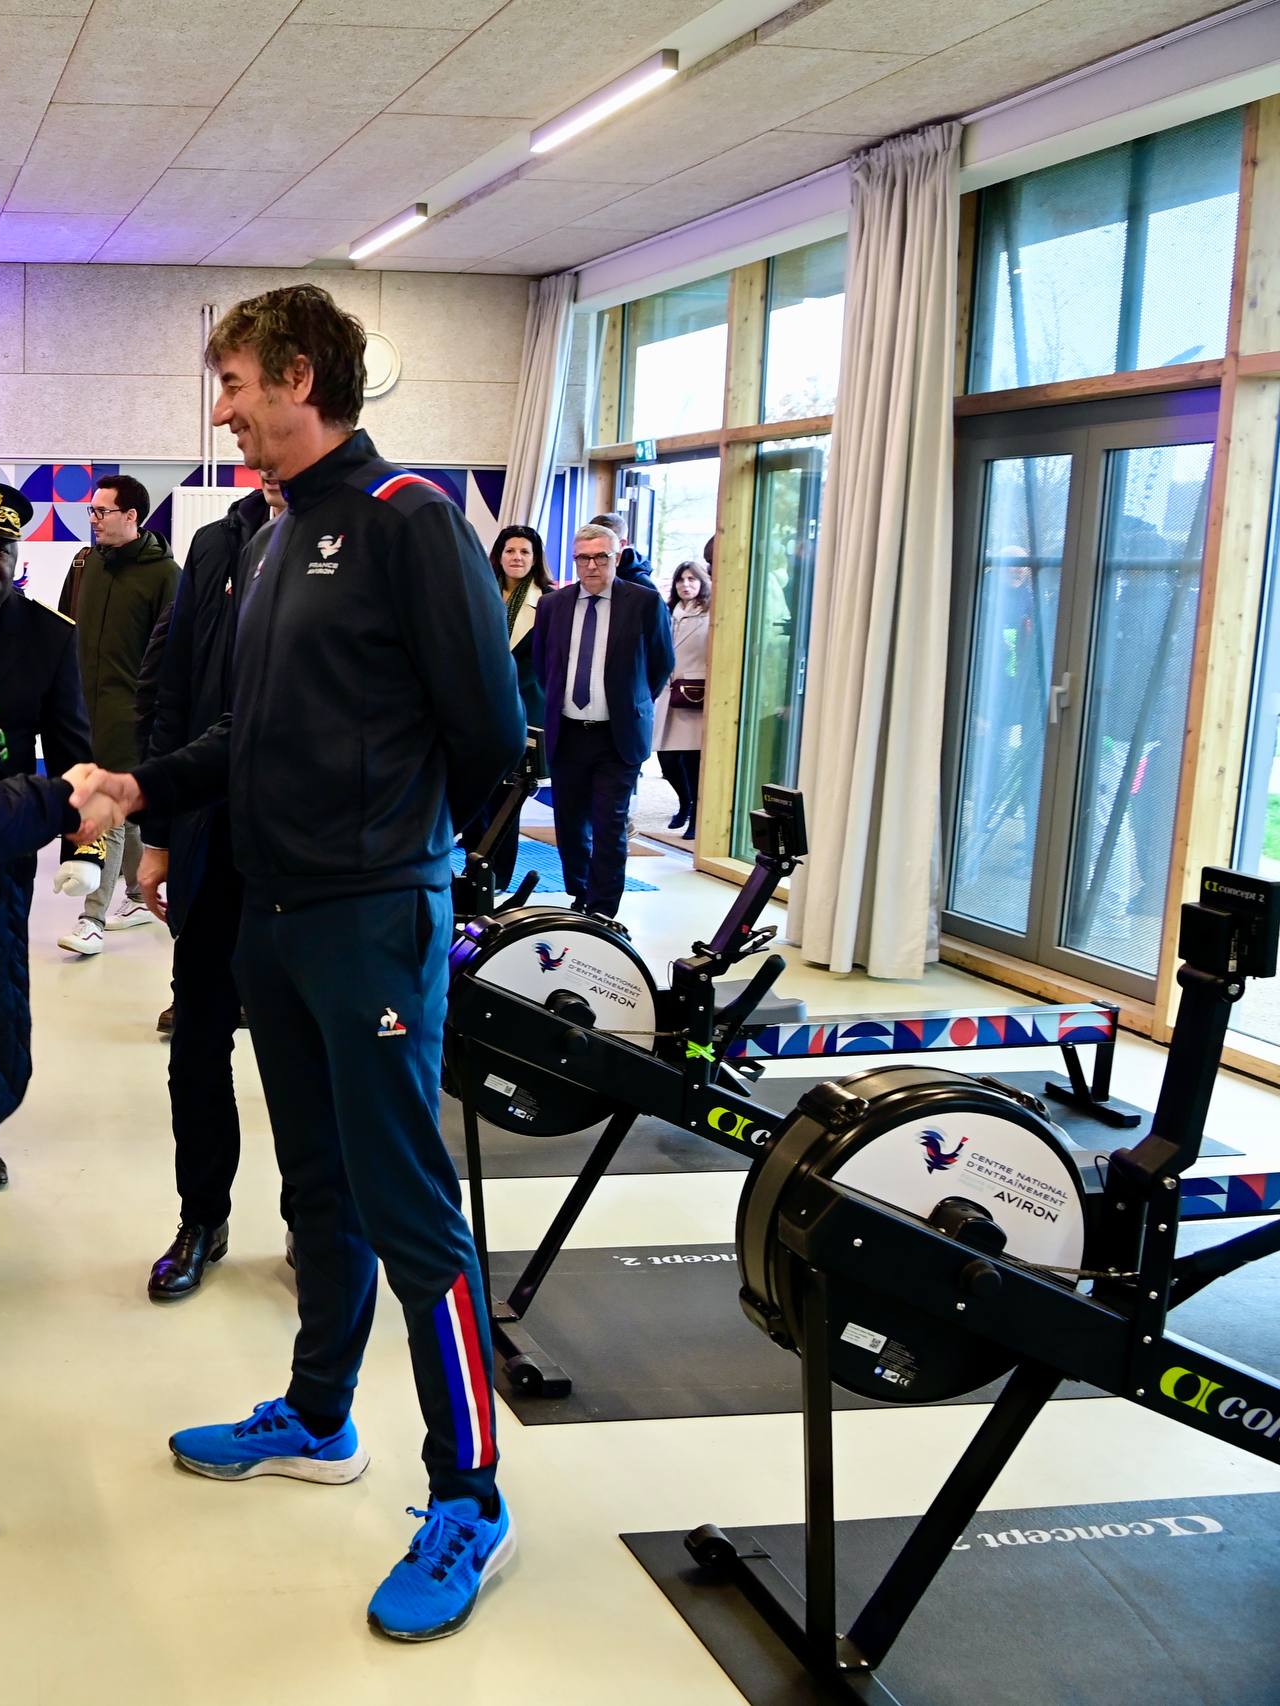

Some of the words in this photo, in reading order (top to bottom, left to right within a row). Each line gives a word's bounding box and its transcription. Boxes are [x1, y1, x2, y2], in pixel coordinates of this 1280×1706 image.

[1218, 885, 1257, 900] concept
[1258, 893, 1265, 903] 2
[571, 957, 602, 974] CENTRE
[604, 971, 642, 993] NATIONAL
[589, 985, 637, 1009] AVIRON
[966, 1160, 1065, 1207] D'ENTRAÎNEMENT
[971, 1152, 1014, 1175] CENTRE
[1016, 1171, 1068, 1199] NATIONAL
[993, 1190, 1059, 1224] AVIRON
[976, 1521, 1155, 1548] concept
